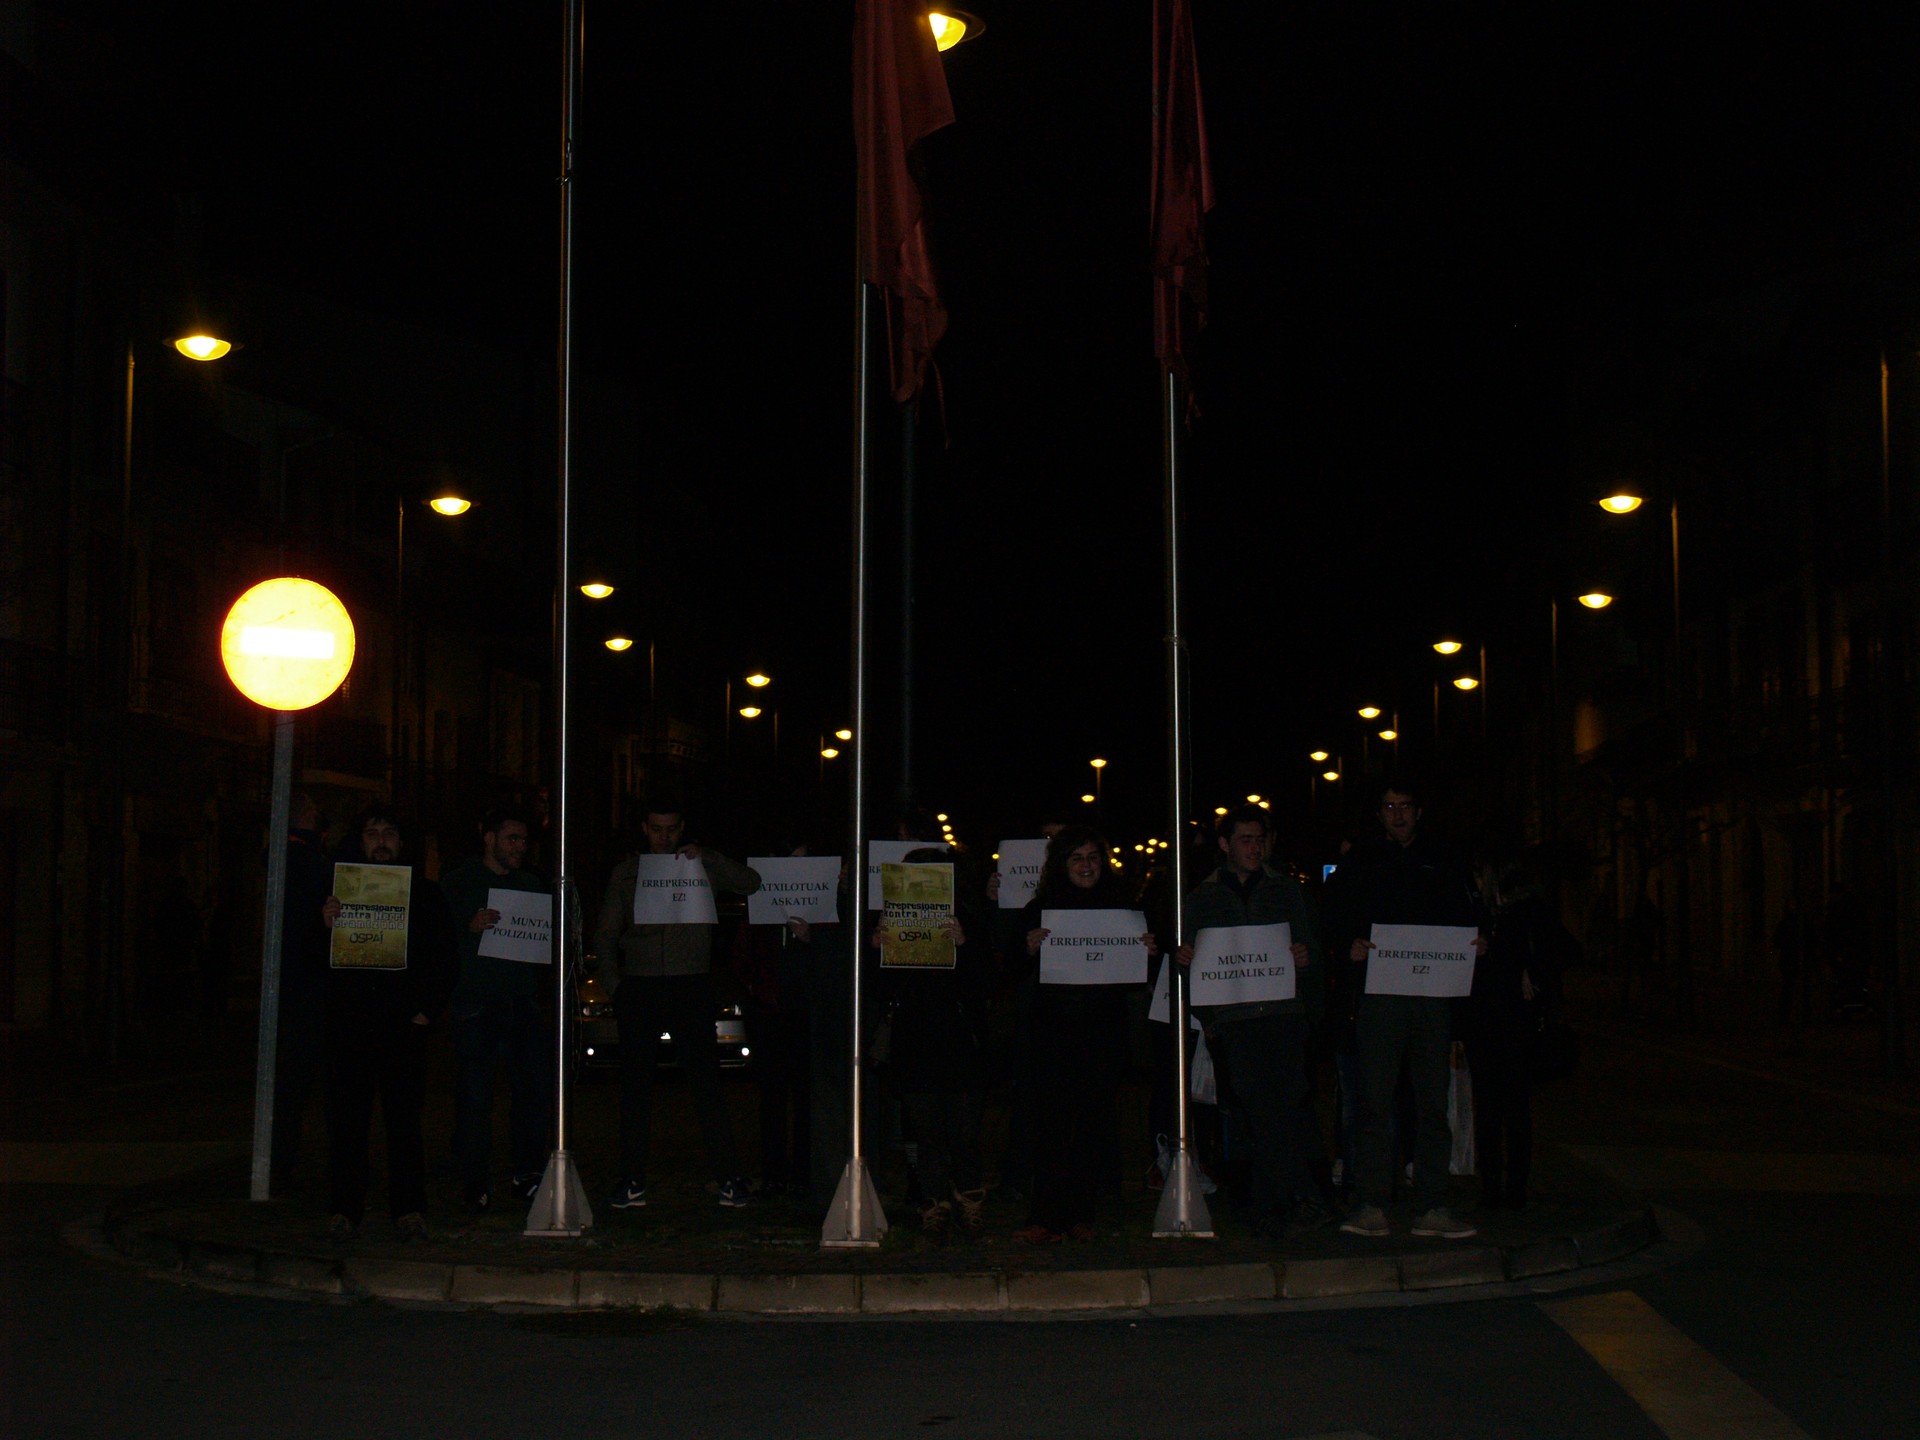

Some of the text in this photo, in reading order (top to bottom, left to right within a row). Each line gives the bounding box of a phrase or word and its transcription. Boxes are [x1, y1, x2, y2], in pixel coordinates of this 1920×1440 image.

[760, 882, 829, 891] ATXILOTUAK
[673, 893, 686, 902] EZ!
[771, 897, 818, 905] ASKATU!
[340, 903, 405, 912] rrepresioaren
[338, 911, 371, 919] ontra
[493, 928, 549, 941] POLIZIALIK
[1050, 937, 1140, 946] ERREPRESIORIK
[1086, 952, 1104, 961] EZ!
[1218, 953, 1268, 965] MUNTAI
[1378, 949, 1467, 961] ERREPRESIORIK
[1201, 966, 1285, 980] POLIZIALIK EZ!
[1412, 965, 1430, 974] EZ!
